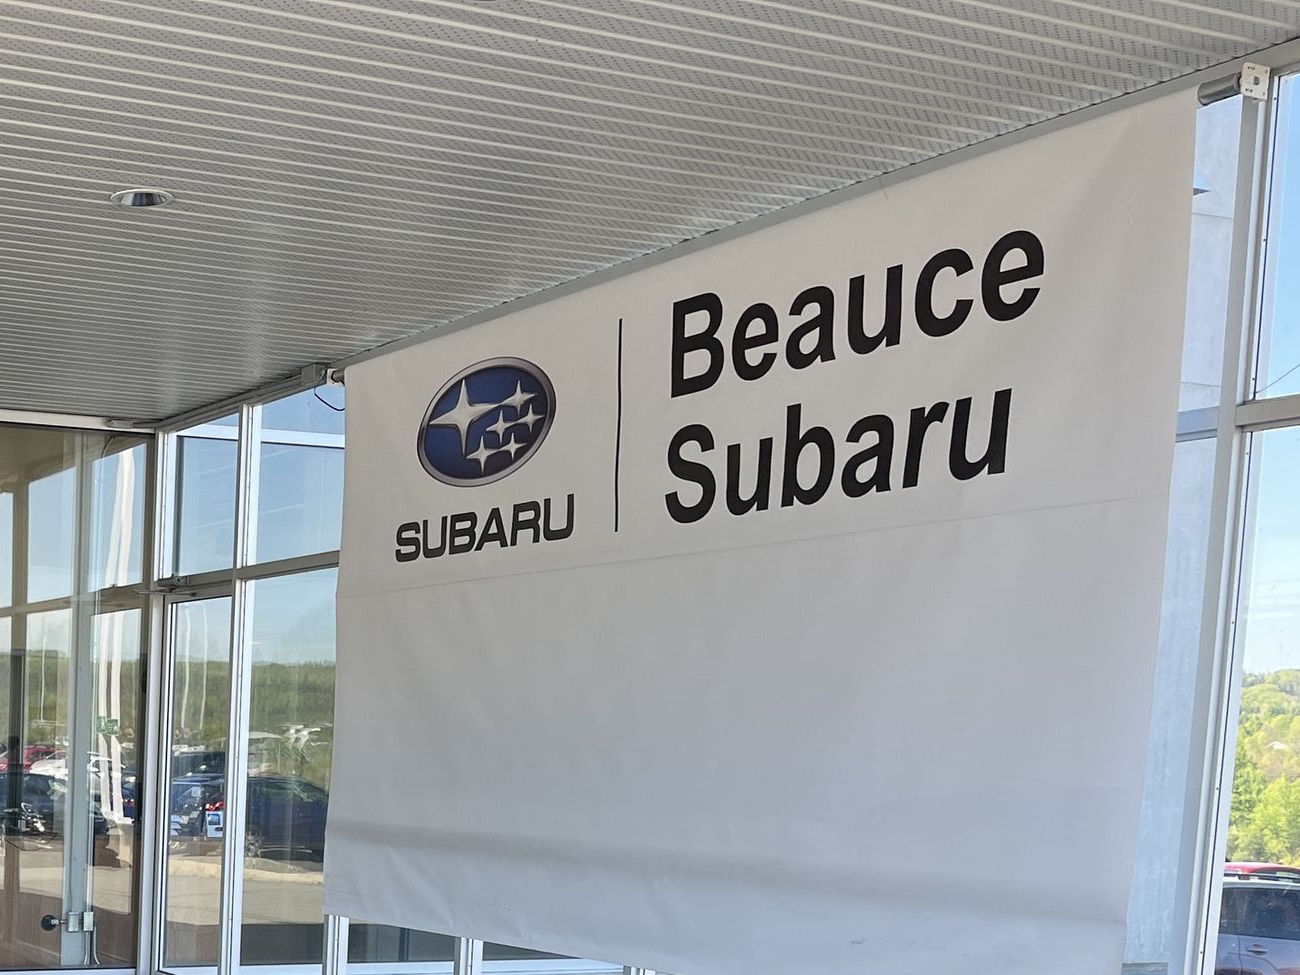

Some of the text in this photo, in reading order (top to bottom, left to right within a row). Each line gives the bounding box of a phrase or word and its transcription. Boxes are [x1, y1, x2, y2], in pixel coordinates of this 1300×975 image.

[670, 230, 1045, 399] Beauce
[664, 387, 1013, 524] Subaru
[395, 493, 575, 563] SUBARU
